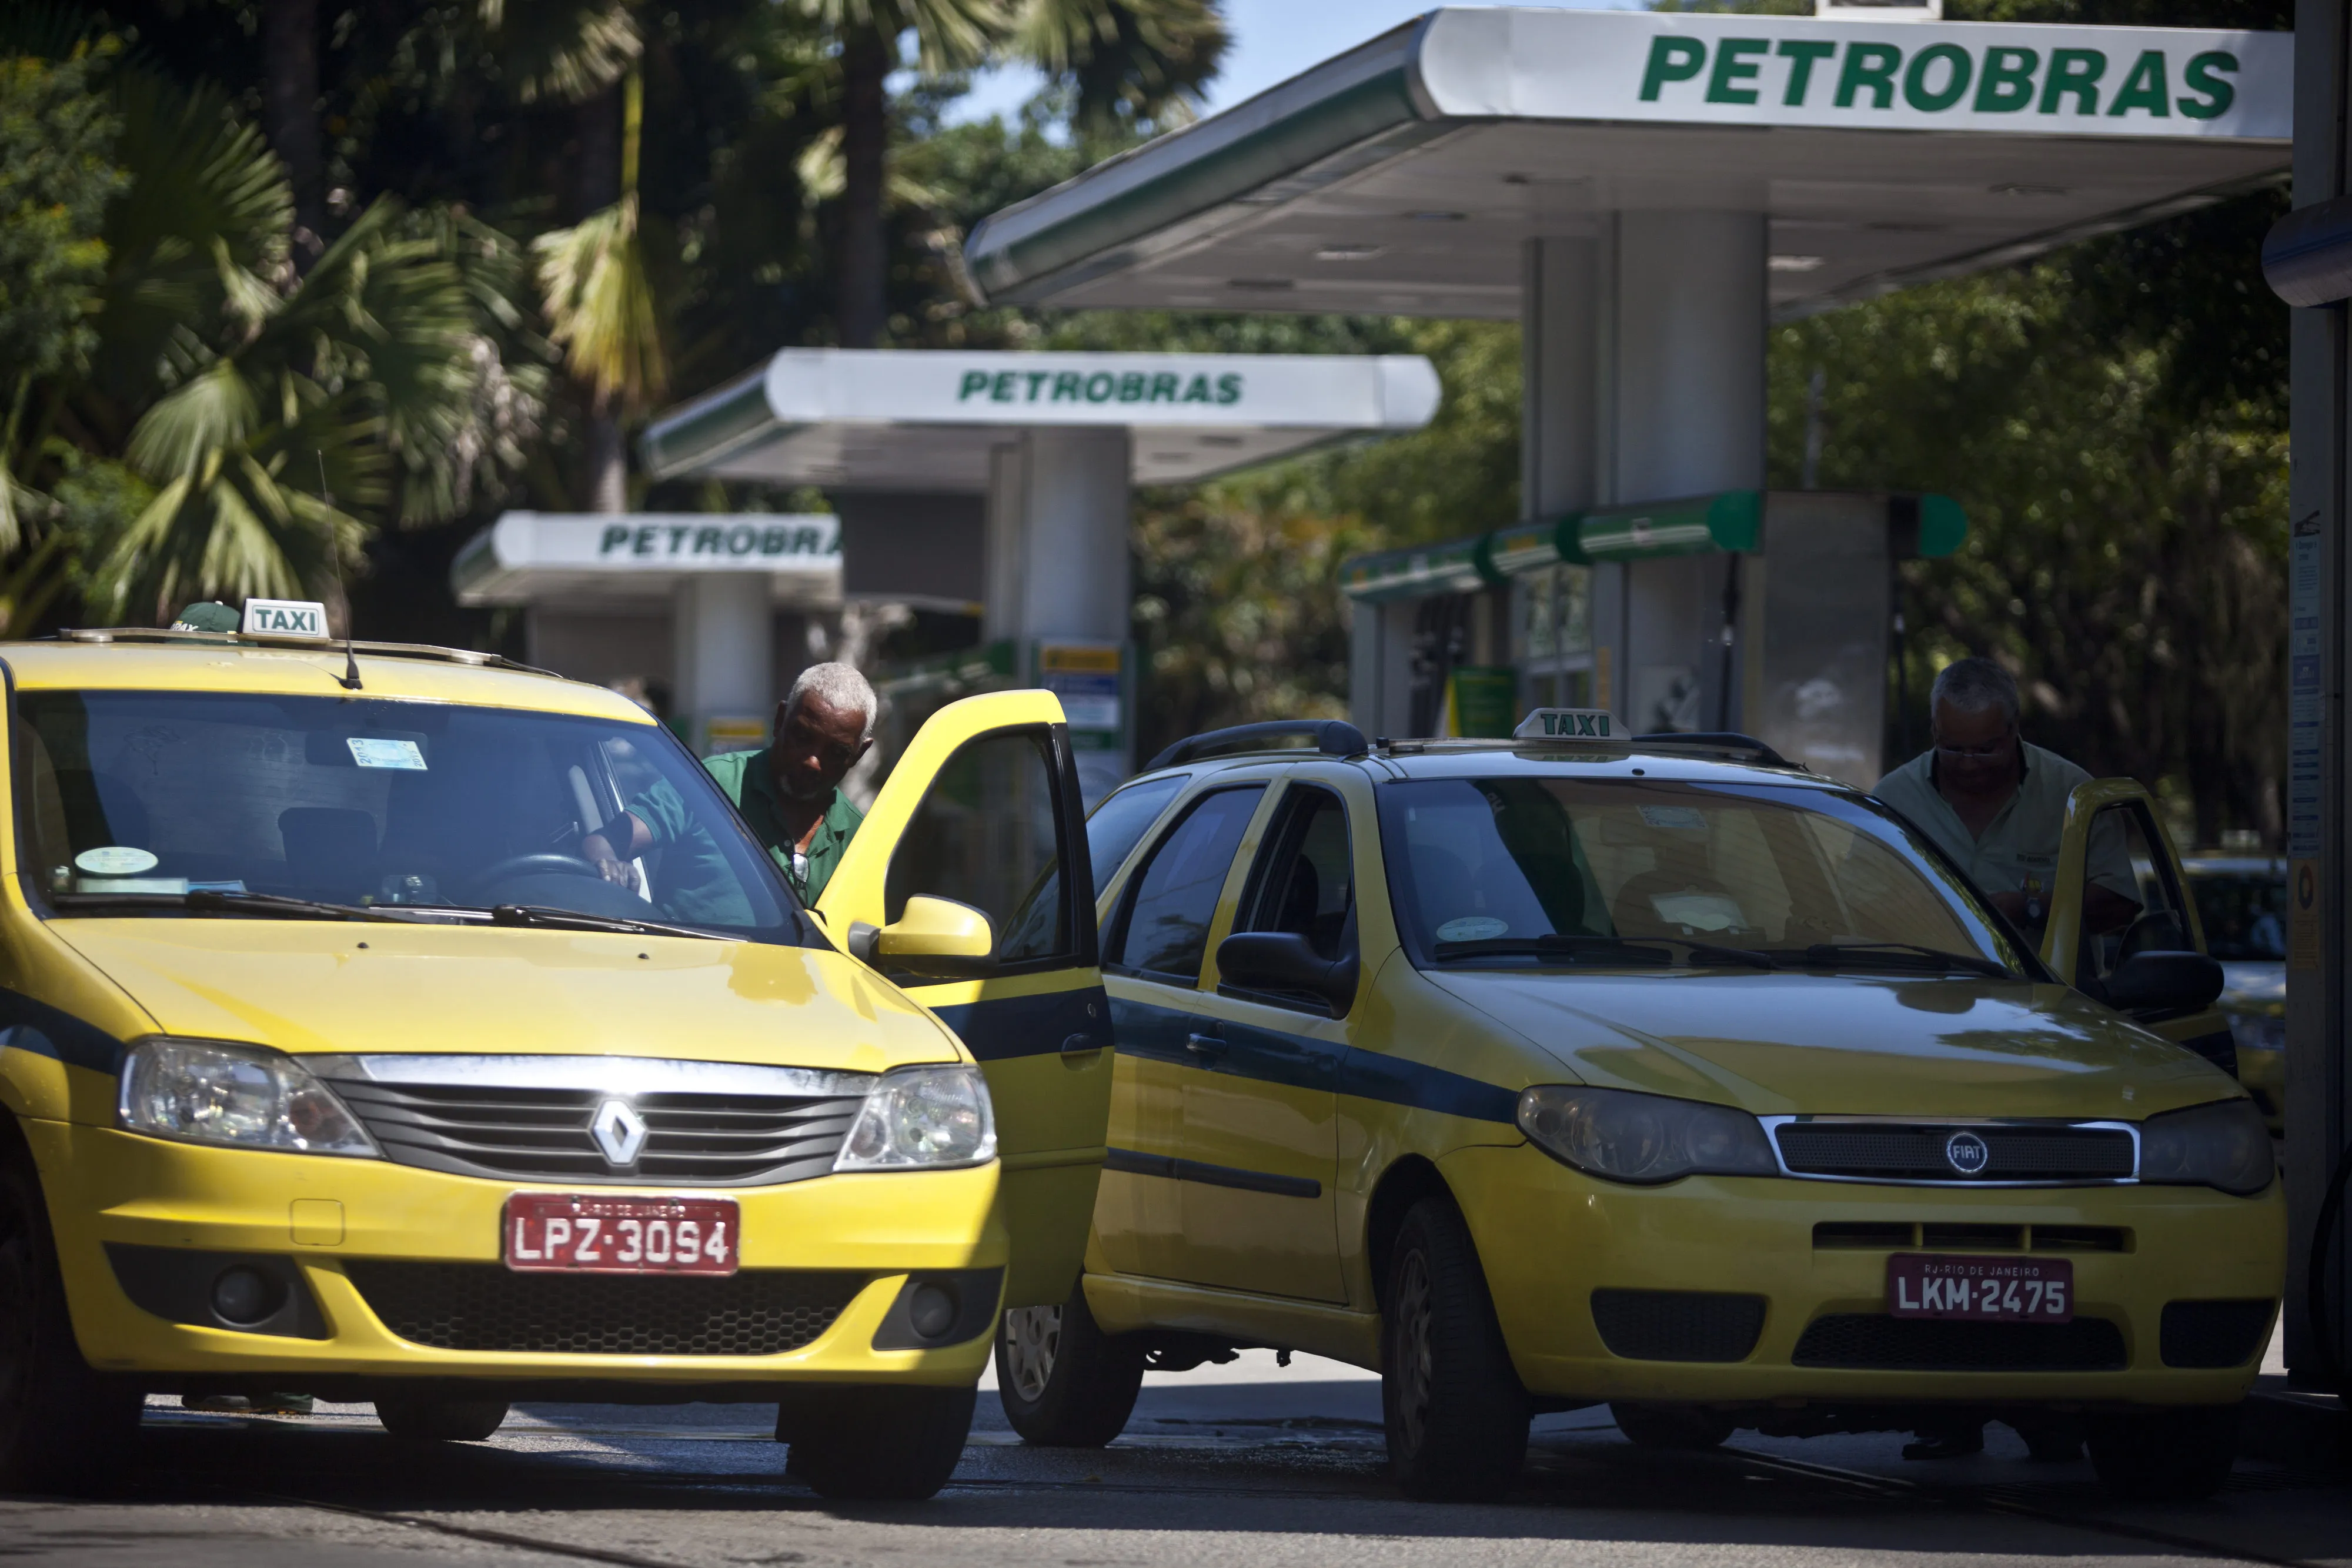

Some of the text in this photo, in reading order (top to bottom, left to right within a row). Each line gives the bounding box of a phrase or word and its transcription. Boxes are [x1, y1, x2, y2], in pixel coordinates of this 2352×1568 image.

[1638, 35, 2240, 119] PETROBRAS
[958, 370, 1242, 404] PETROBRAS
[255, 609, 316, 631] TAXI
[1541, 714, 1610, 737] TAXI
[1953, 1145, 1980, 1159] FIAT
[1970, 1266, 1984, 1275] DE
[1990, 1266, 2040, 1276] JANEIRO
